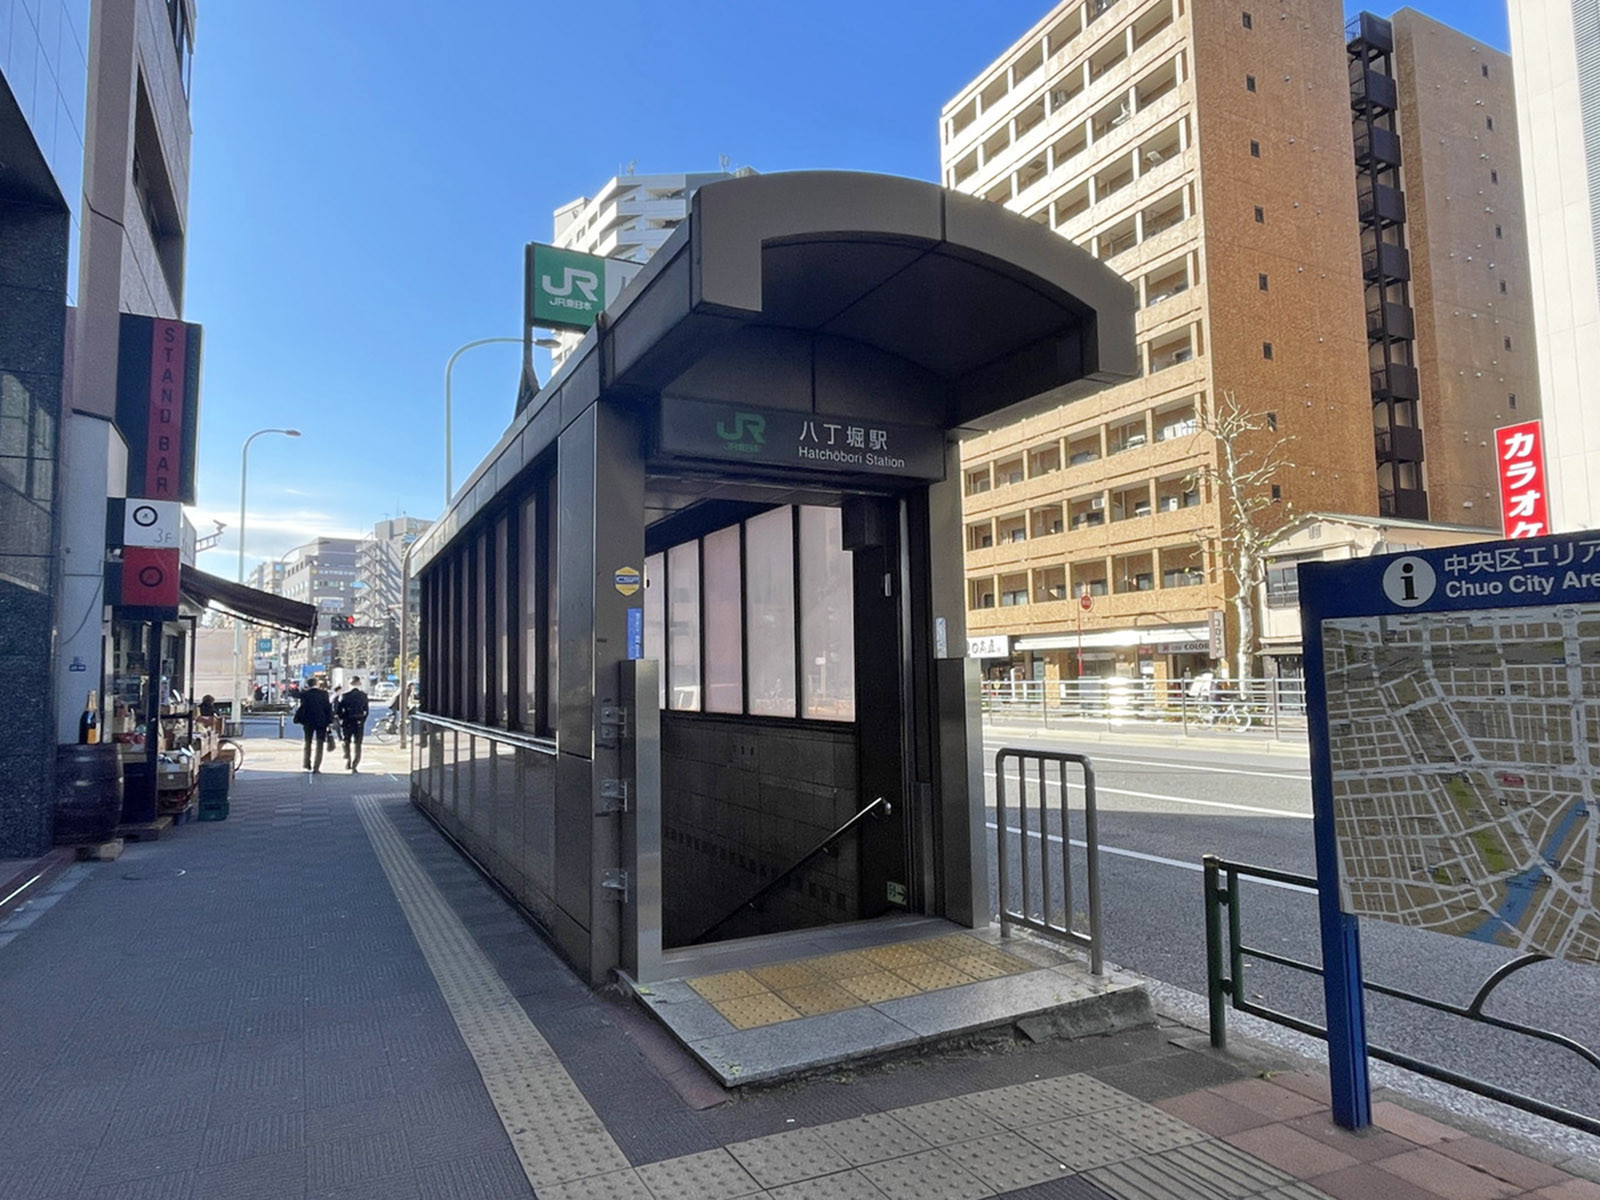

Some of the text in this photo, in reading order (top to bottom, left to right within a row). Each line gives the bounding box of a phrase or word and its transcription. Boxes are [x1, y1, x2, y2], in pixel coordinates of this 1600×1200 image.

[542, 267, 598, 302] JR
[549, 297, 592, 311] JR東日本
[157, 327, 175, 492] STAND BAR
[717, 411, 766, 444] JR
[799, 421, 888, 450] 八丁堀駅
[866, 453, 905, 468] Station
[153, 528, 173, 543] 3F
[1444, 540, 1600, 577] 中央区エリア
[1445, 577, 1504, 598] Chuo
[1509, 573, 1554, 596] City
